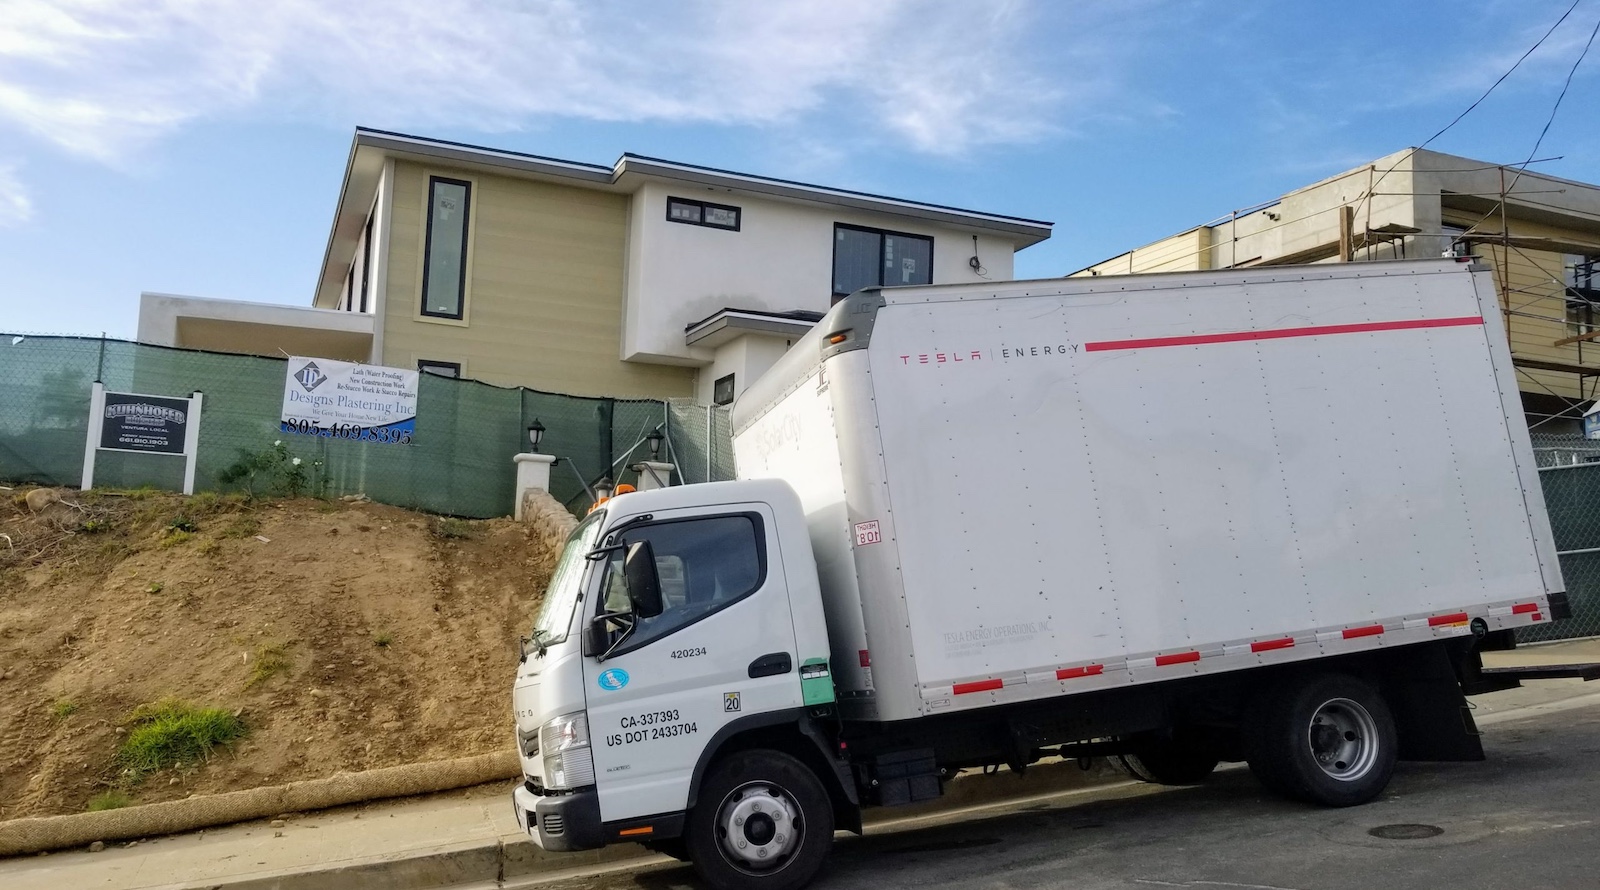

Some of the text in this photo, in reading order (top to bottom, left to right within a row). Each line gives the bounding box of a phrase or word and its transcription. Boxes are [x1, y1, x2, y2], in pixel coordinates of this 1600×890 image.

[900, 344, 1079, 365] TESLA ENERGY
[352, 368, 364, 376] Lath
[337, 383, 361, 392] Re-Stucco
[362, 386, 374, 394] Work
[382, 388, 397, 396] Stucco
[398, 390, 416, 399] Repairs
[362, 378, 392, 388] Construction
[290, 390, 415, 415] Designs Plastering Inc.
[106, 404, 185, 423] KUHNHOFER
[286, 418, 412, 444] 805.469.8395
[119, 438, 168, 446] 661.810.1903
[944, 632, 965, 644] TESLA
[966, 627, 992, 642] ENERGY
[670, 647, 707, 659] 420234
[726, 698, 739, 710] 20
[620, 710, 680, 729] CA-337393
[606, 722, 698, 746] US DOT 2433704
